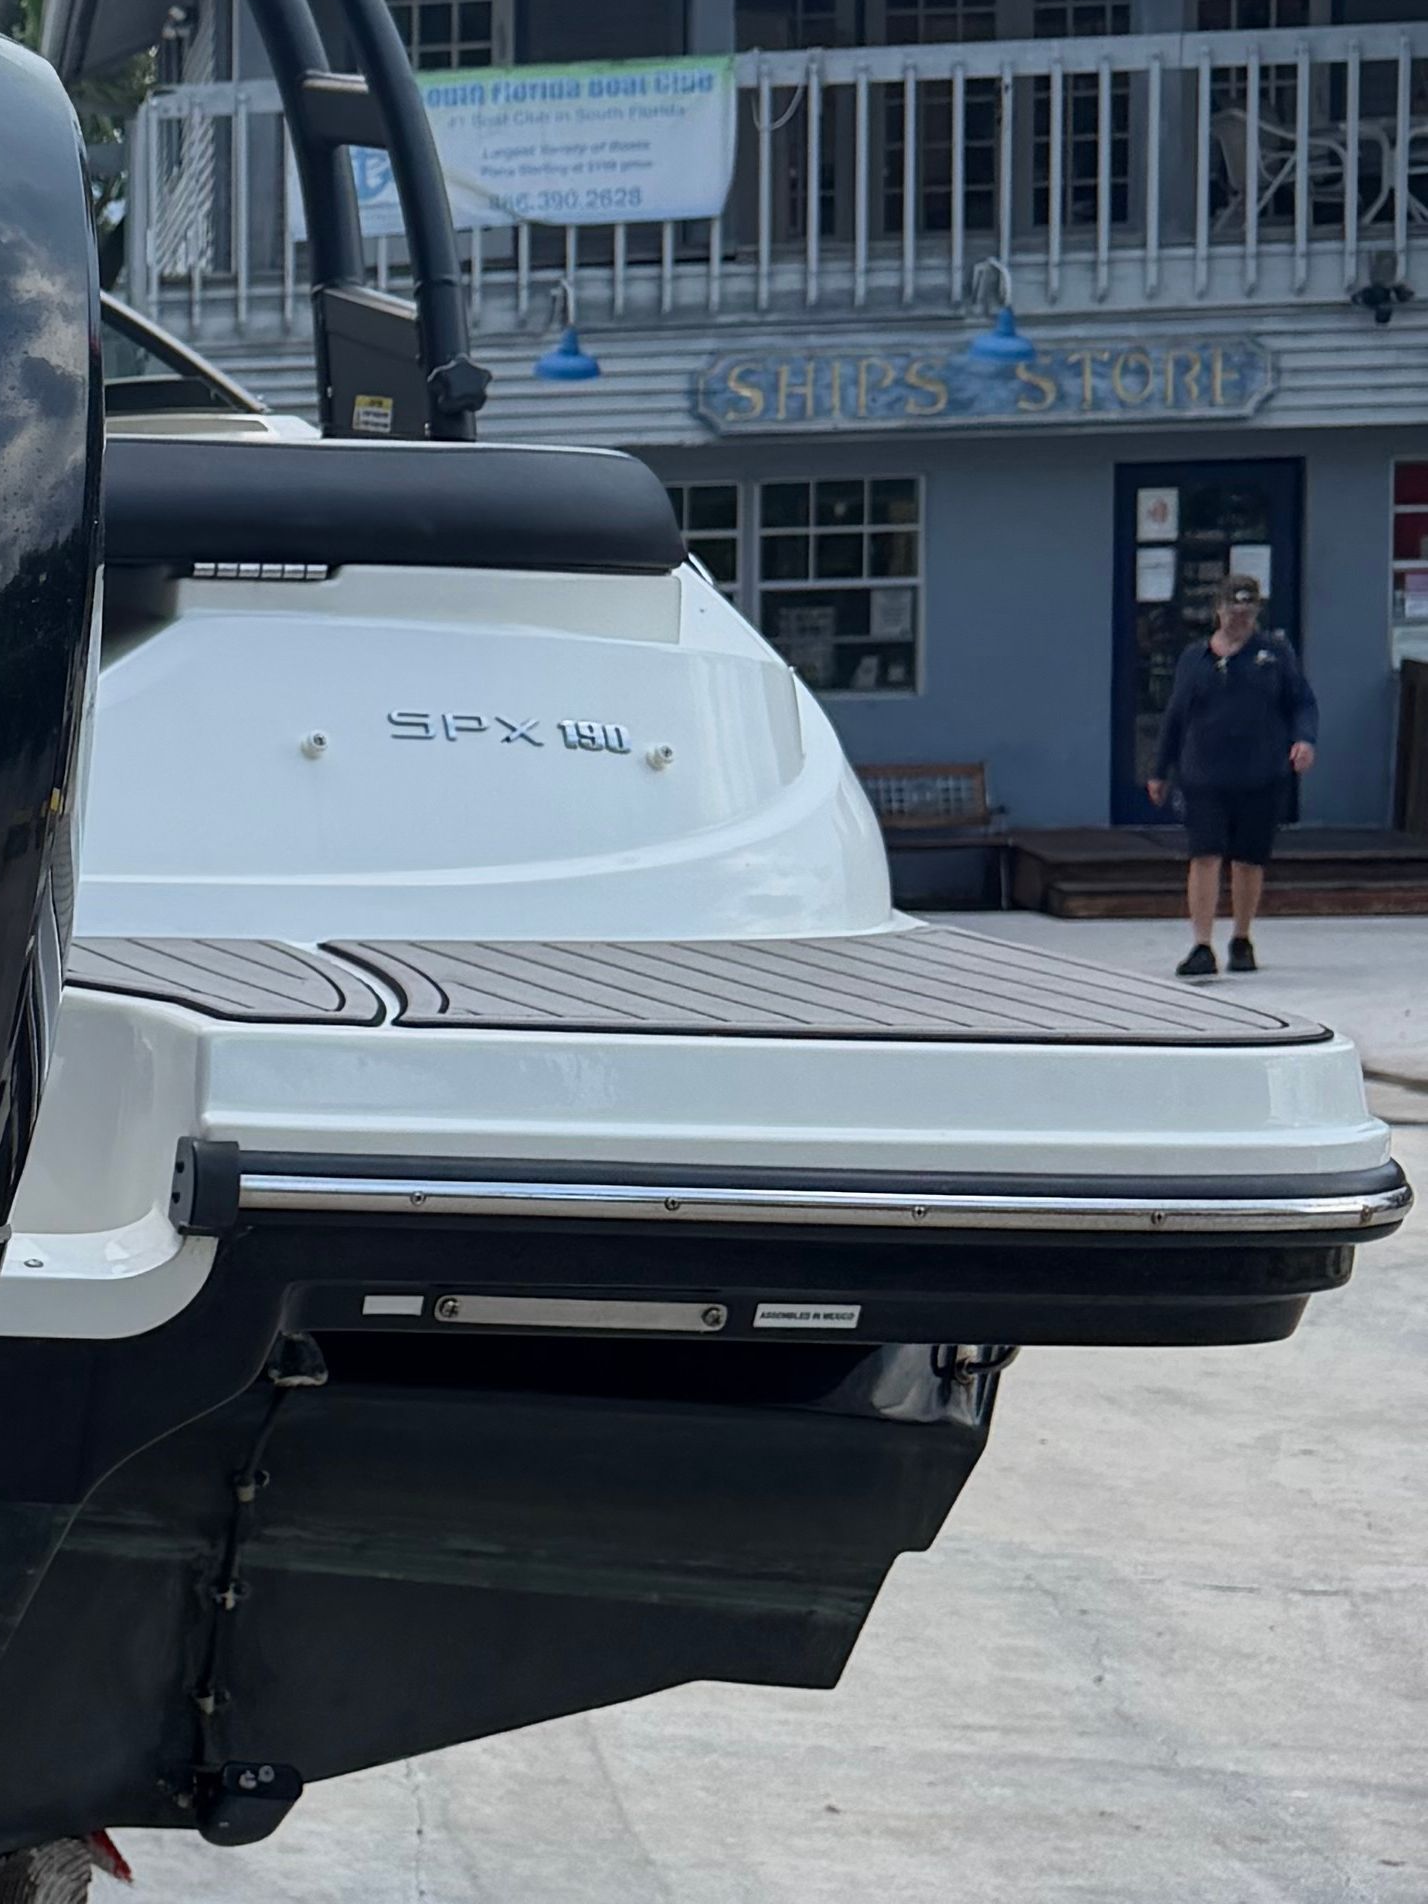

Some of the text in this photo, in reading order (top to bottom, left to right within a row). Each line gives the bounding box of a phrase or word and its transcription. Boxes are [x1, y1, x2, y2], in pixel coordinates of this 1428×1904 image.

[425, 82, 485, 107] outh
[725, 347, 1243, 422] SHIPS STORE
[386, 709, 632, 755] SPX 190
